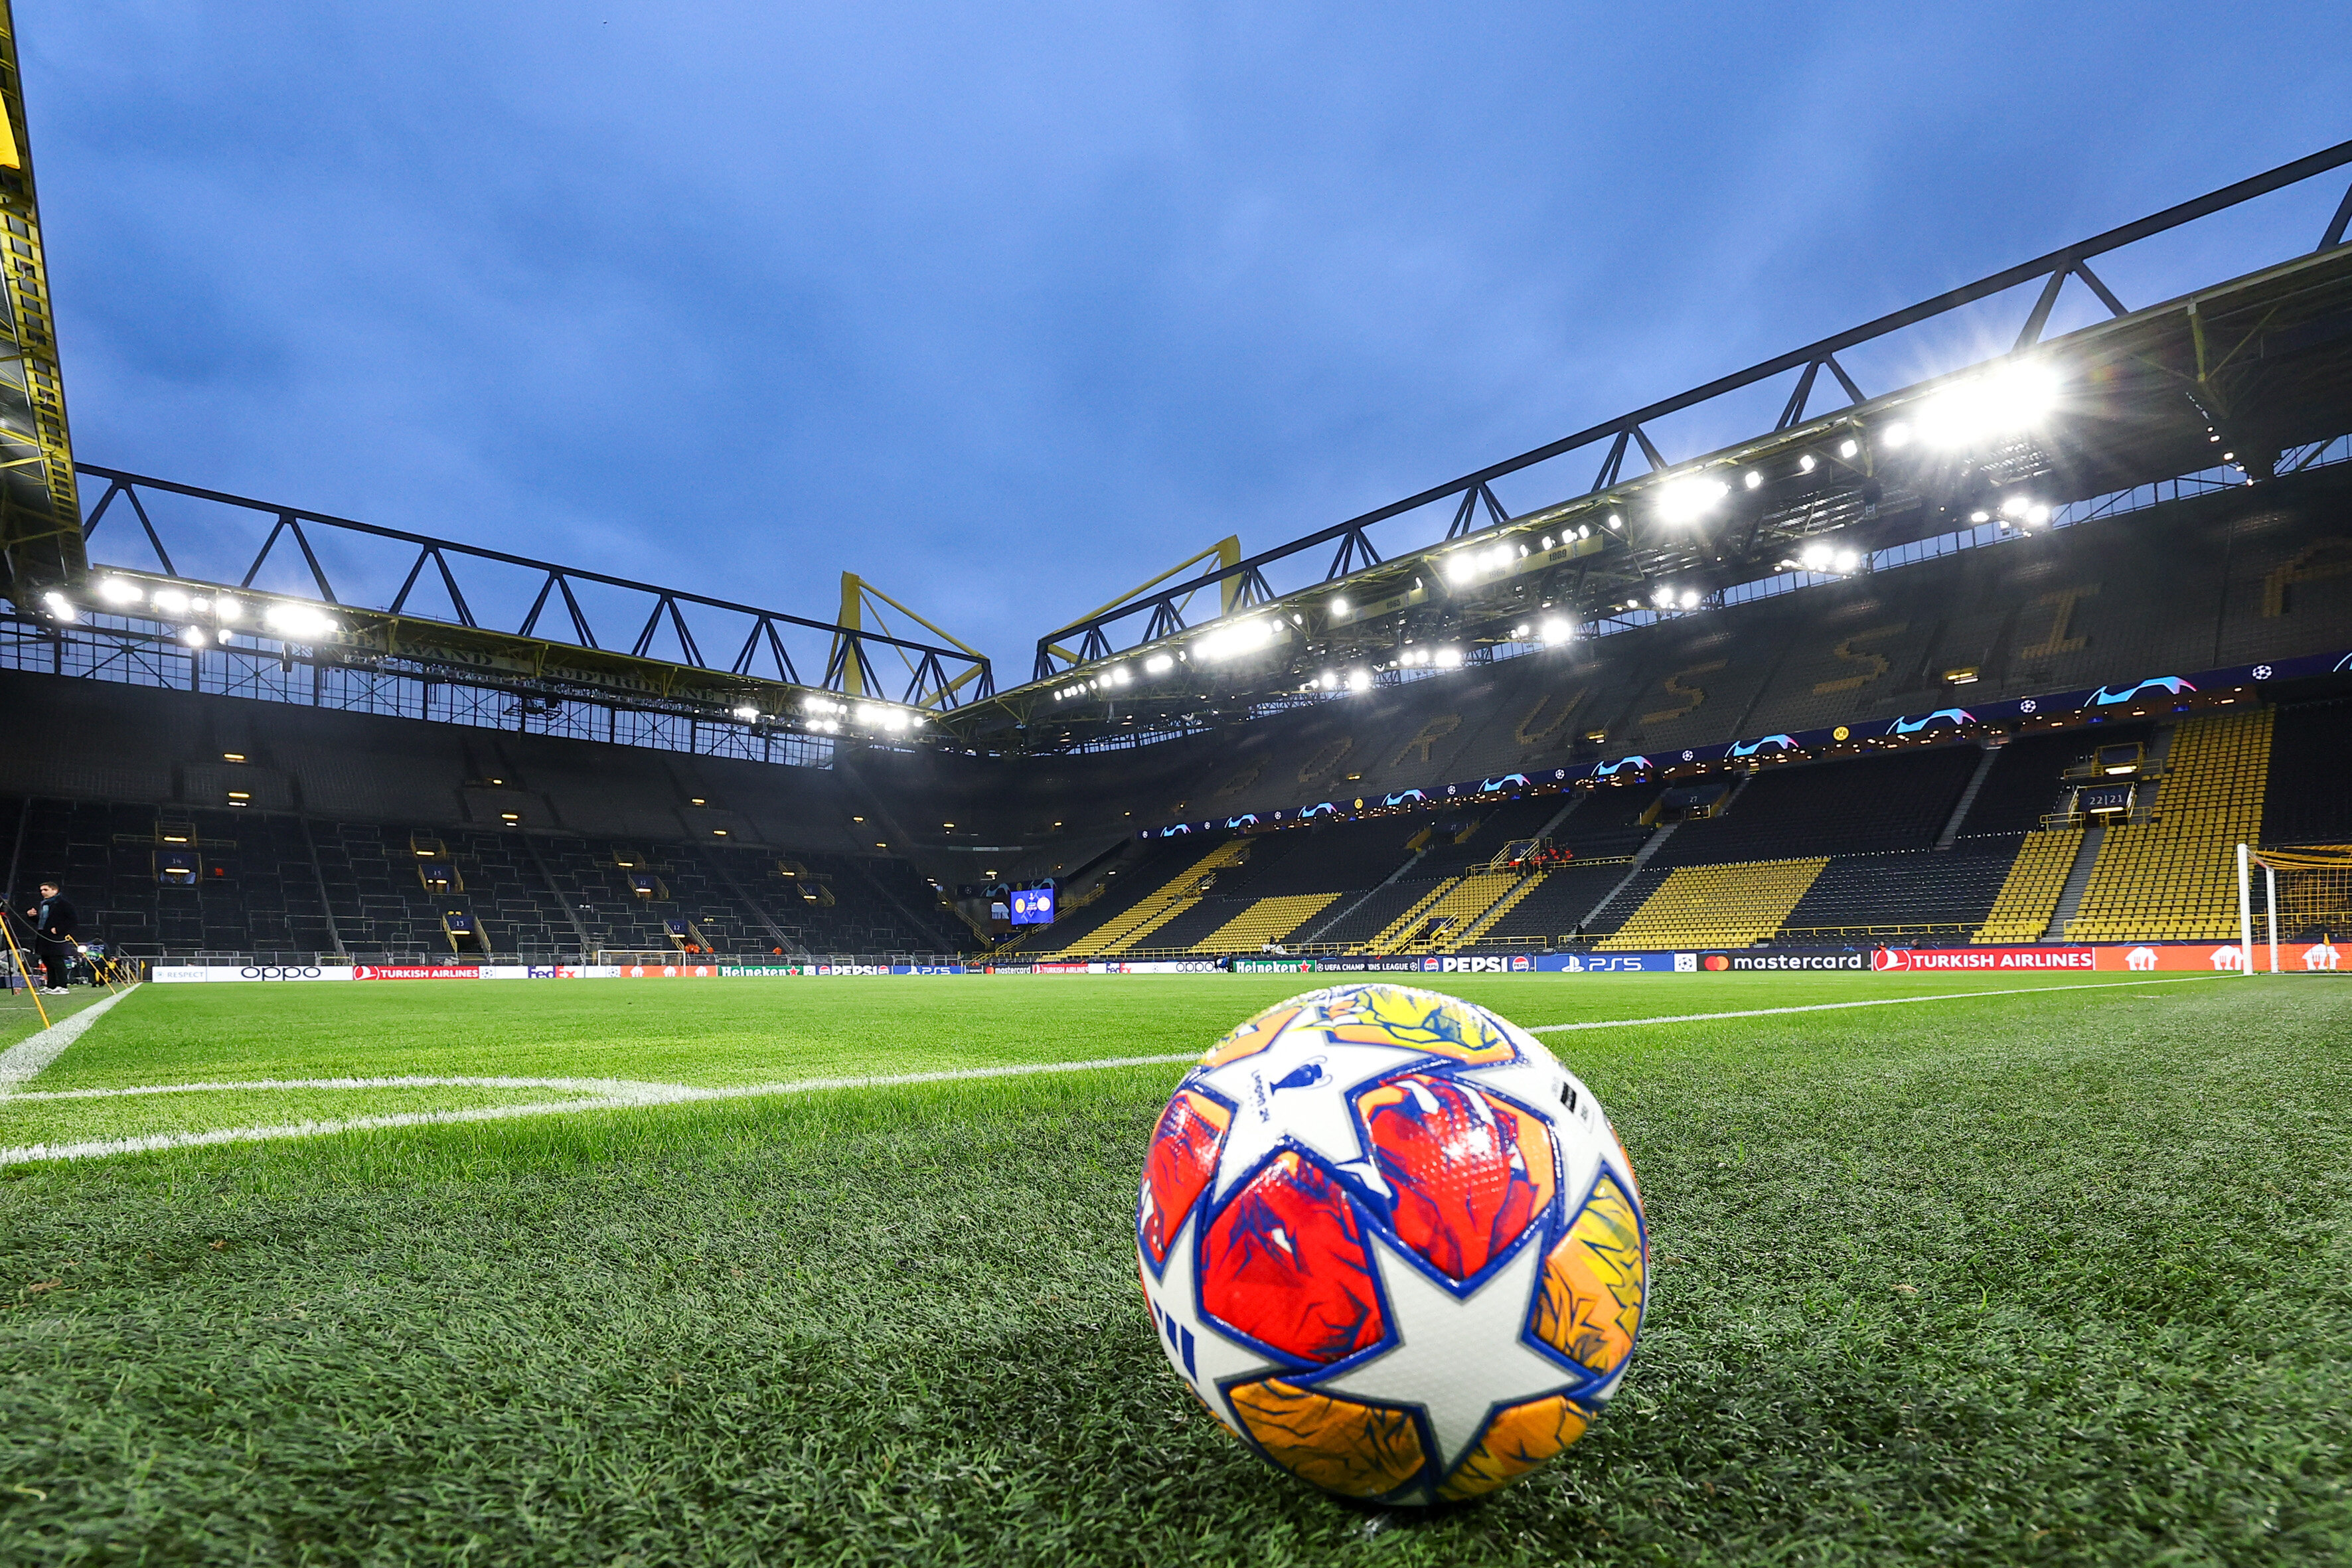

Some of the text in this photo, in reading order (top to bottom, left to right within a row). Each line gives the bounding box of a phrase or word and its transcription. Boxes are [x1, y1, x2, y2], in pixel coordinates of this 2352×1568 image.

[1020, 890, 1040, 923] TET
[1236, 961, 1296, 973] Heineken
[1443, 957, 1508, 972] PEPSI
[1589, 957, 1642, 971] PS5
[1734, 954, 1861, 969] mastercard
[1913, 953, 2092, 968] TURKISH AIRLINES
[241, 967, 321, 981] oppo
[380, 969, 479, 979] TURKISH AIRLINES
[528, 966, 576, 978] FedEx
[721, 966, 787, 977] Heineken
[832, 966, 877, 975] PEPSI
[1106, 963, 1131, 973] FedEx
